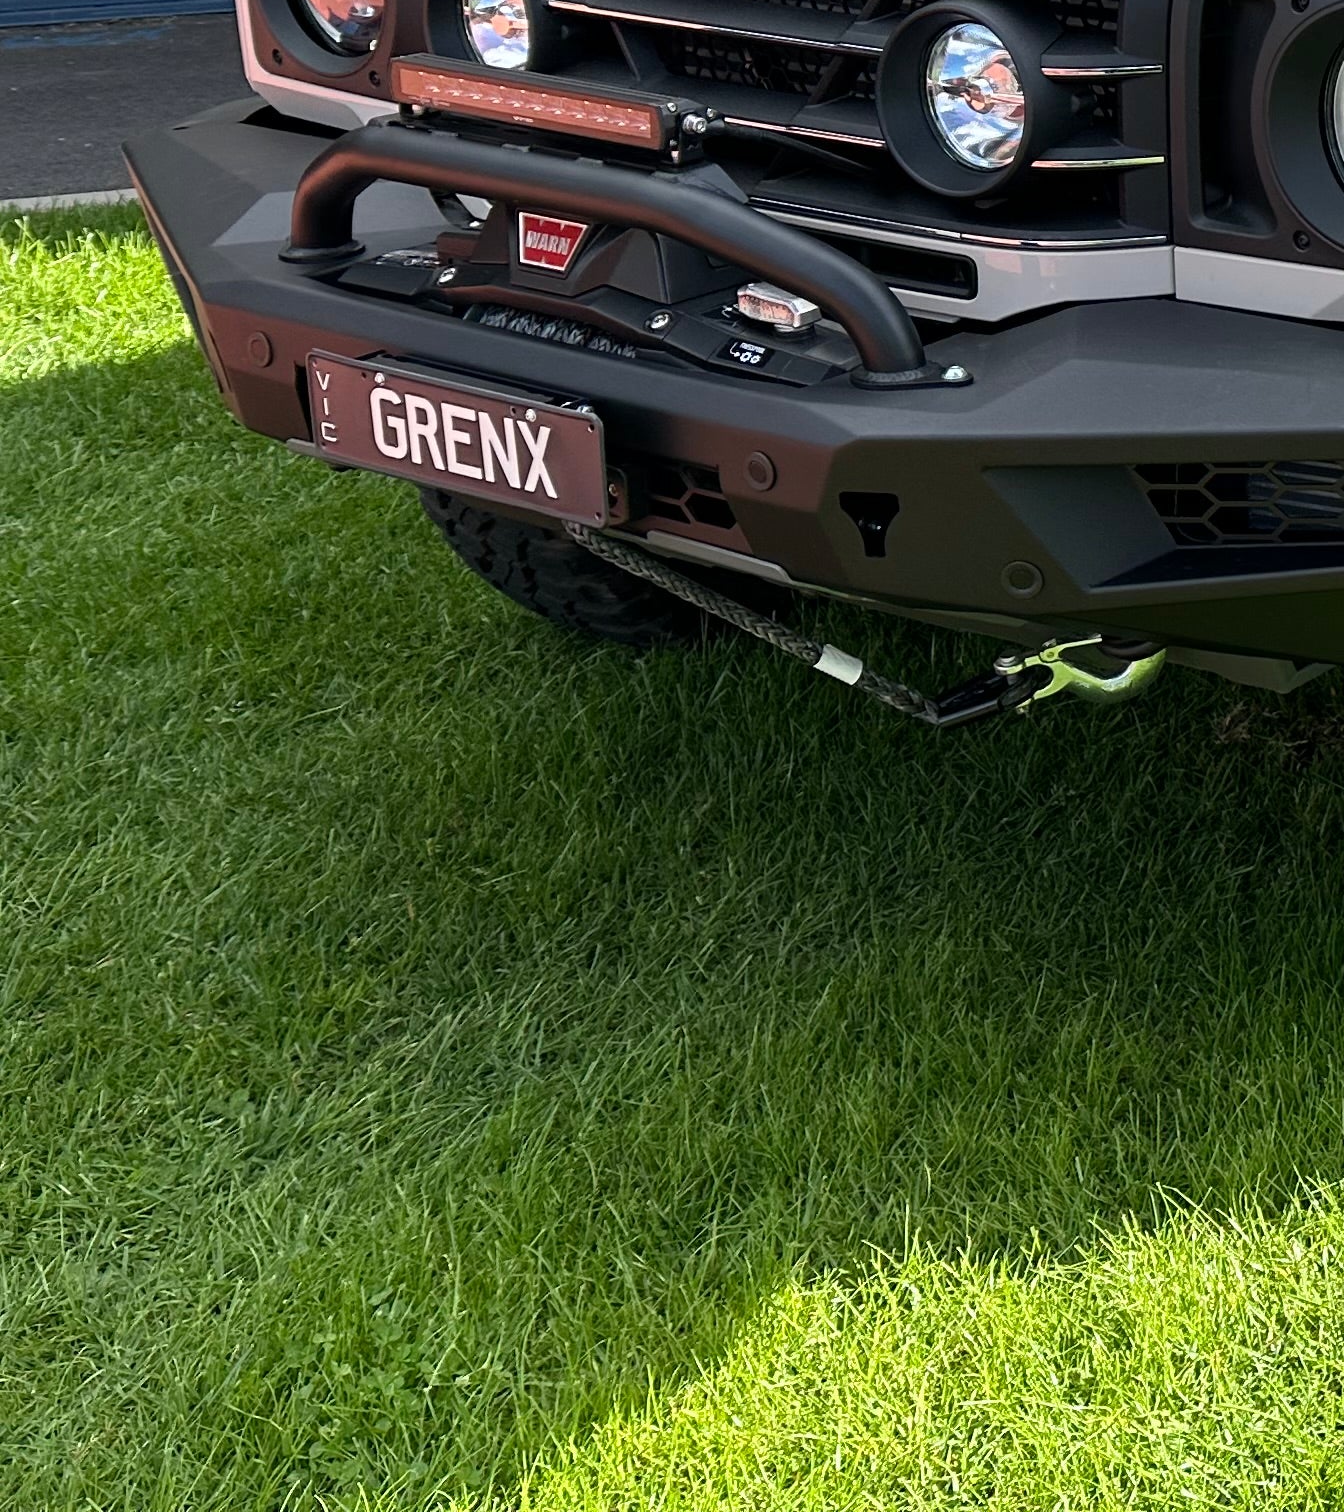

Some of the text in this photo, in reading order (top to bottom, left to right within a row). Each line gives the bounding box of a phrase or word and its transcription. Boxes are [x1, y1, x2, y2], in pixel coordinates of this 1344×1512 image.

[525, 229, 571, 257] WARN
[316, 371, 338, 443] VIC
[369, 386, 559, 500] GRENX
